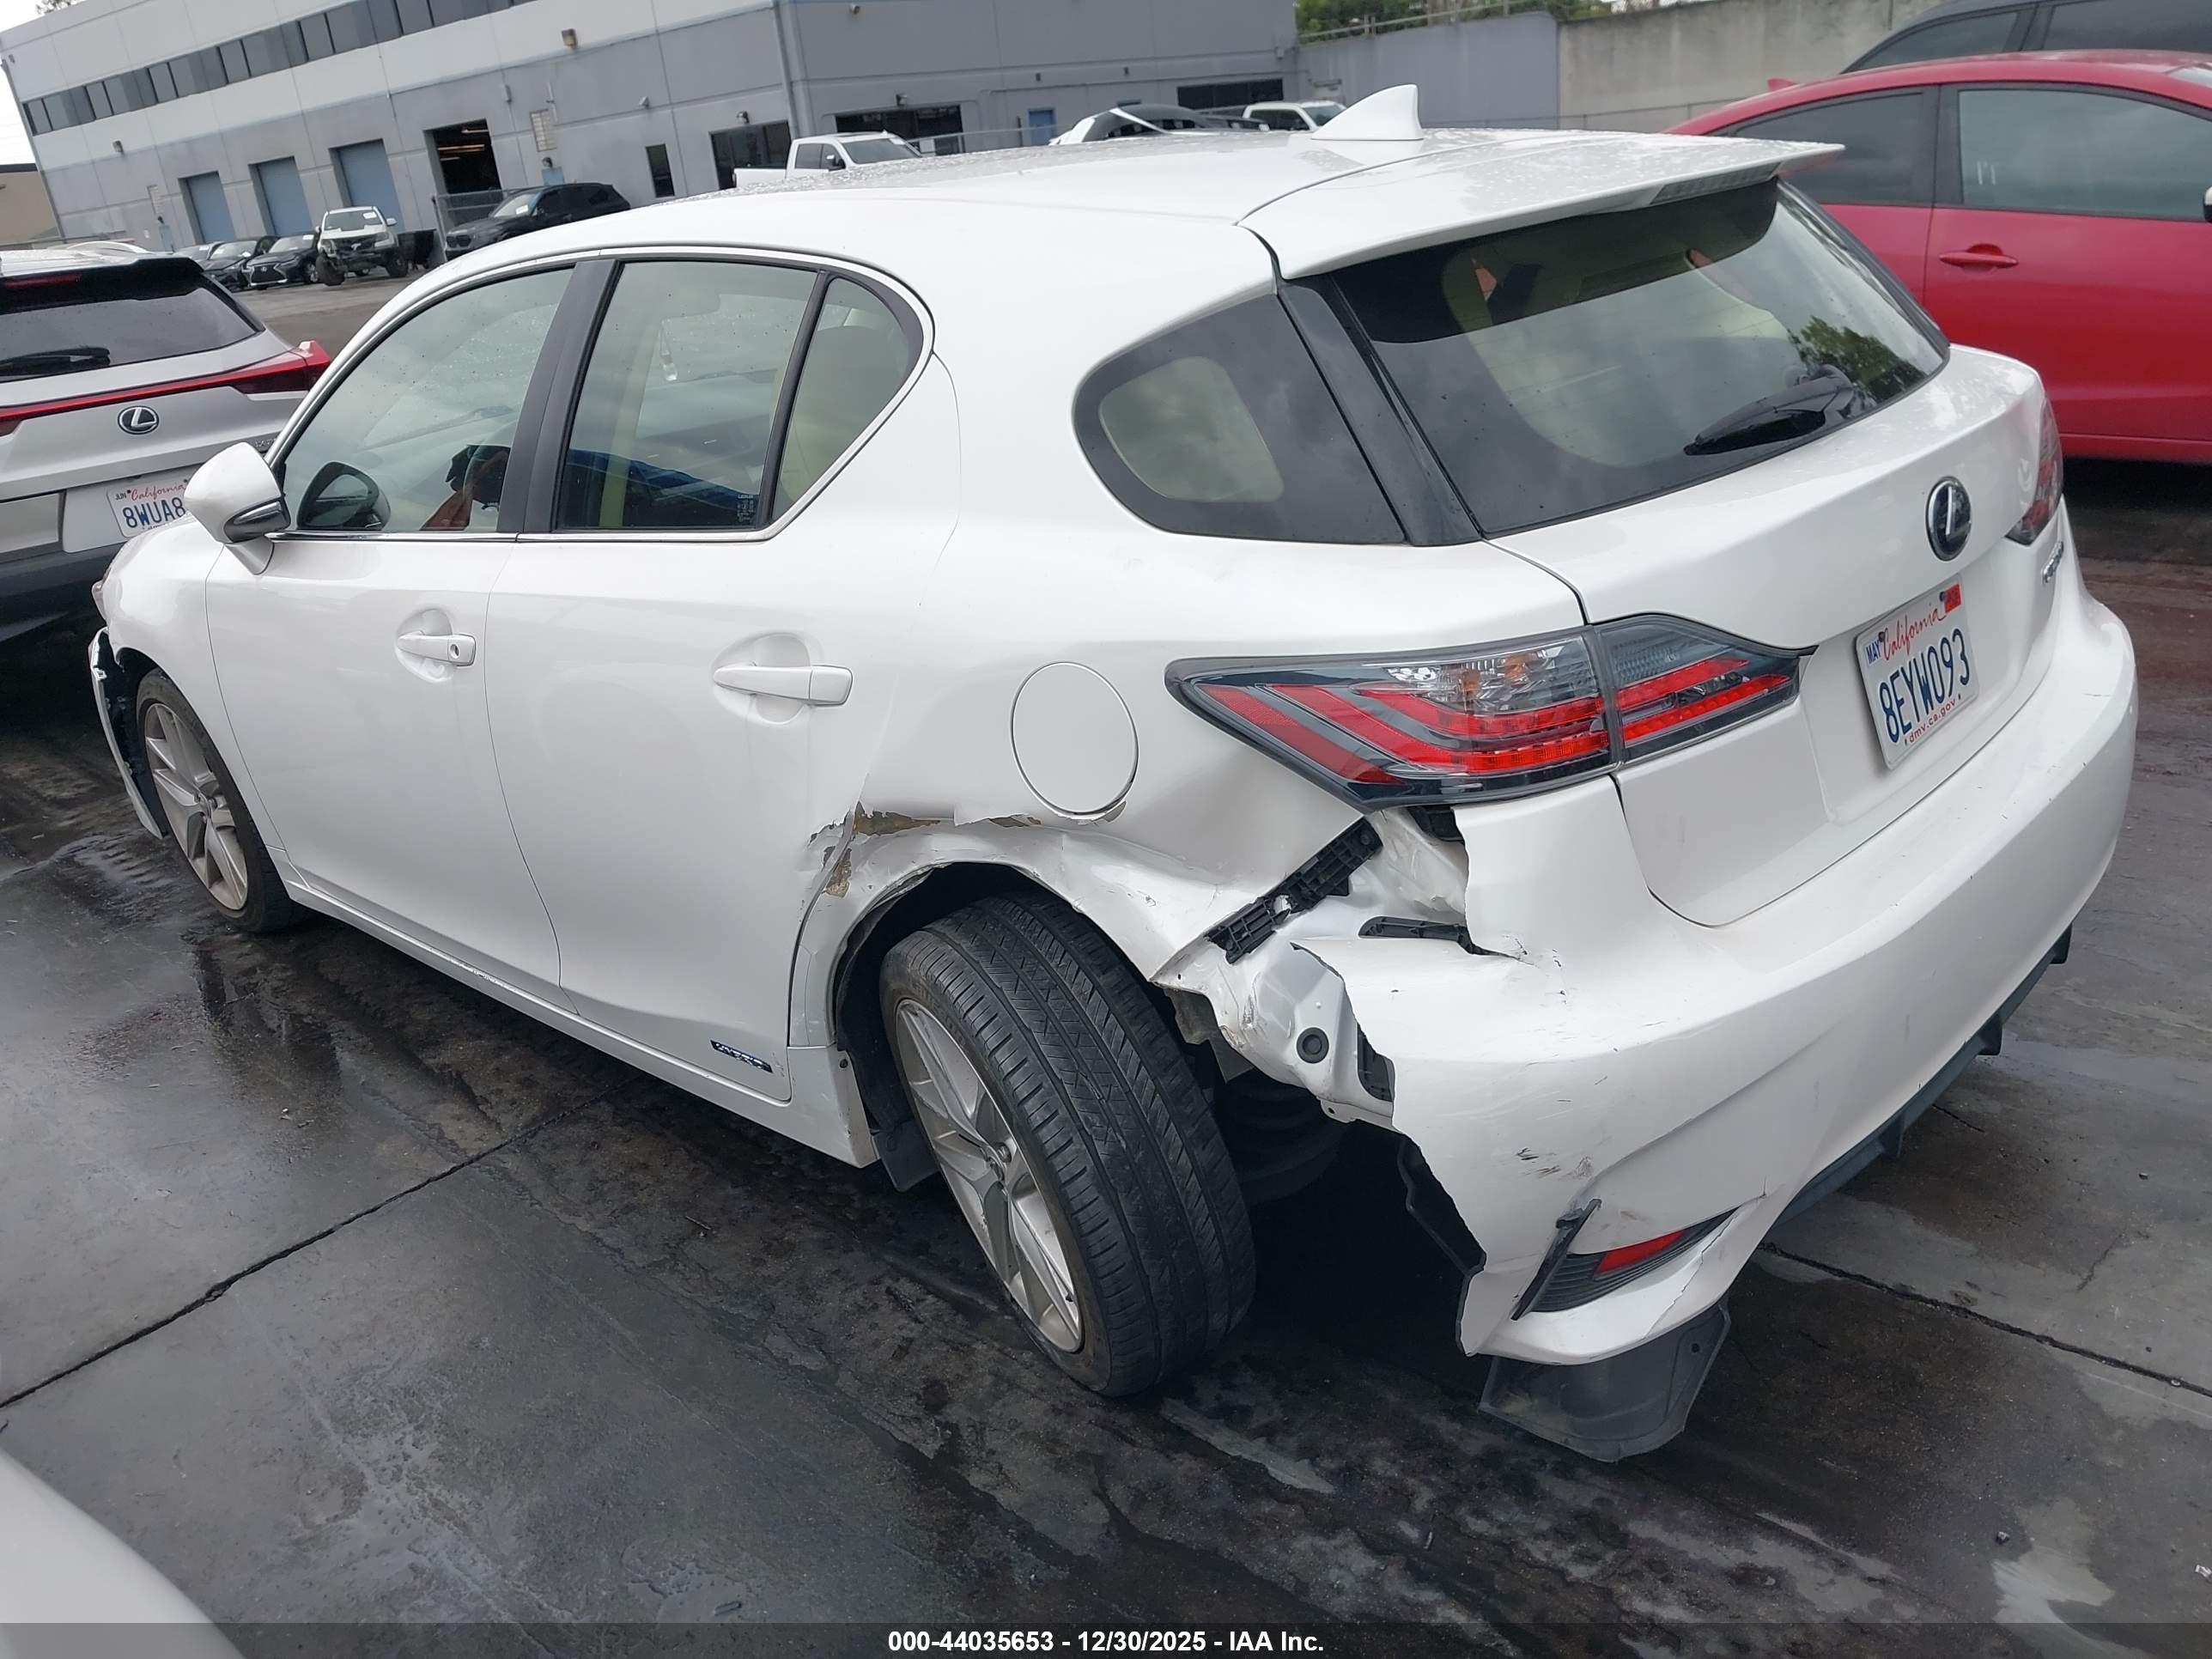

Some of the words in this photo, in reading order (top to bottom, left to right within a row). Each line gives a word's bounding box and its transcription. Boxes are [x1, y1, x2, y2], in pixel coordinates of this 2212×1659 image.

[131, 483, 186, 501] California
[1866, 639, 1881, 664] MAY
[1881, 605, 1945, 660] California
[1879, 629, 1970, 744] 8EYW093
[1908, 698, 1956, 744] dmv.ca.gov
